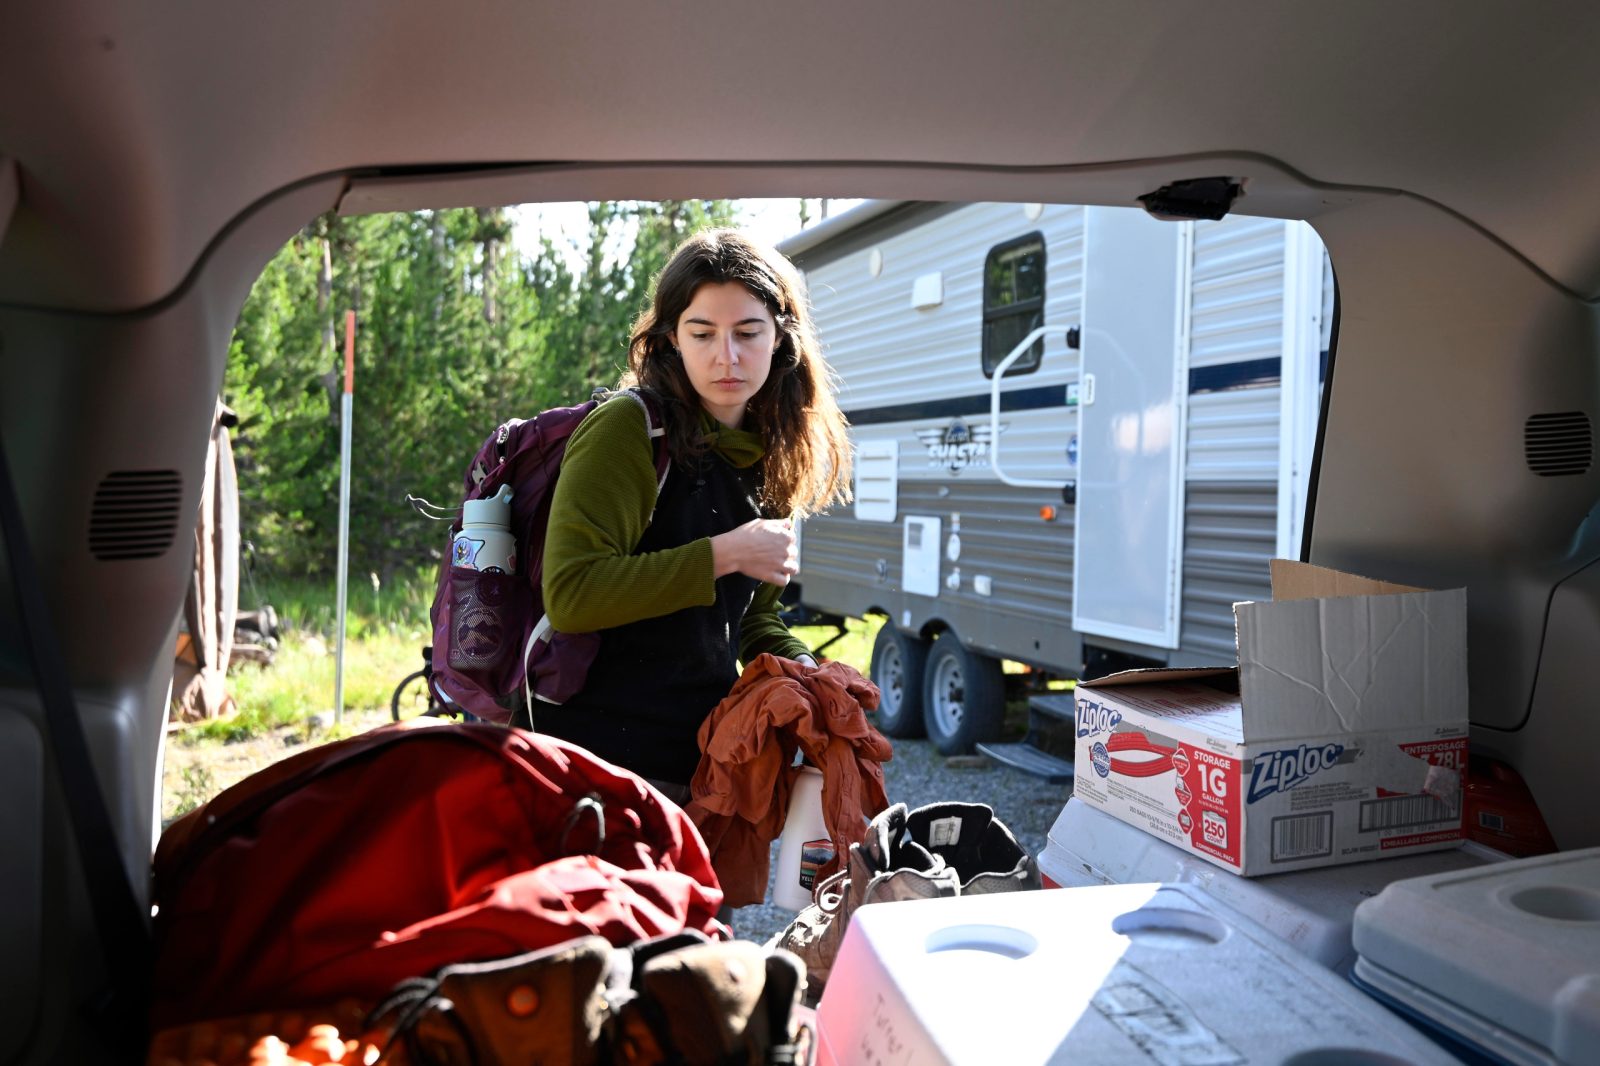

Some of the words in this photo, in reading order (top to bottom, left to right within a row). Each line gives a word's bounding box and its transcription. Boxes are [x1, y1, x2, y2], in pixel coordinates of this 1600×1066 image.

[1077, 699, 1119, 738] Ziploc
[1404, 741, 1466, 754] ENTREPOSAGE
[1194, 750, 1231, 770] STORAGE
[1253, 743, 1338, 794] Ziploc
[1197, 764, 1227, 798] 1G
[1202, 792, 1224, 806] GALLON
[1204, 818, 1226, 840] 250
[1206, 833, 1224, 846] COUNT
[1195, 841, 1222, 859] COMMERCIAL
[1222, 851, 1235, 863] PACK
